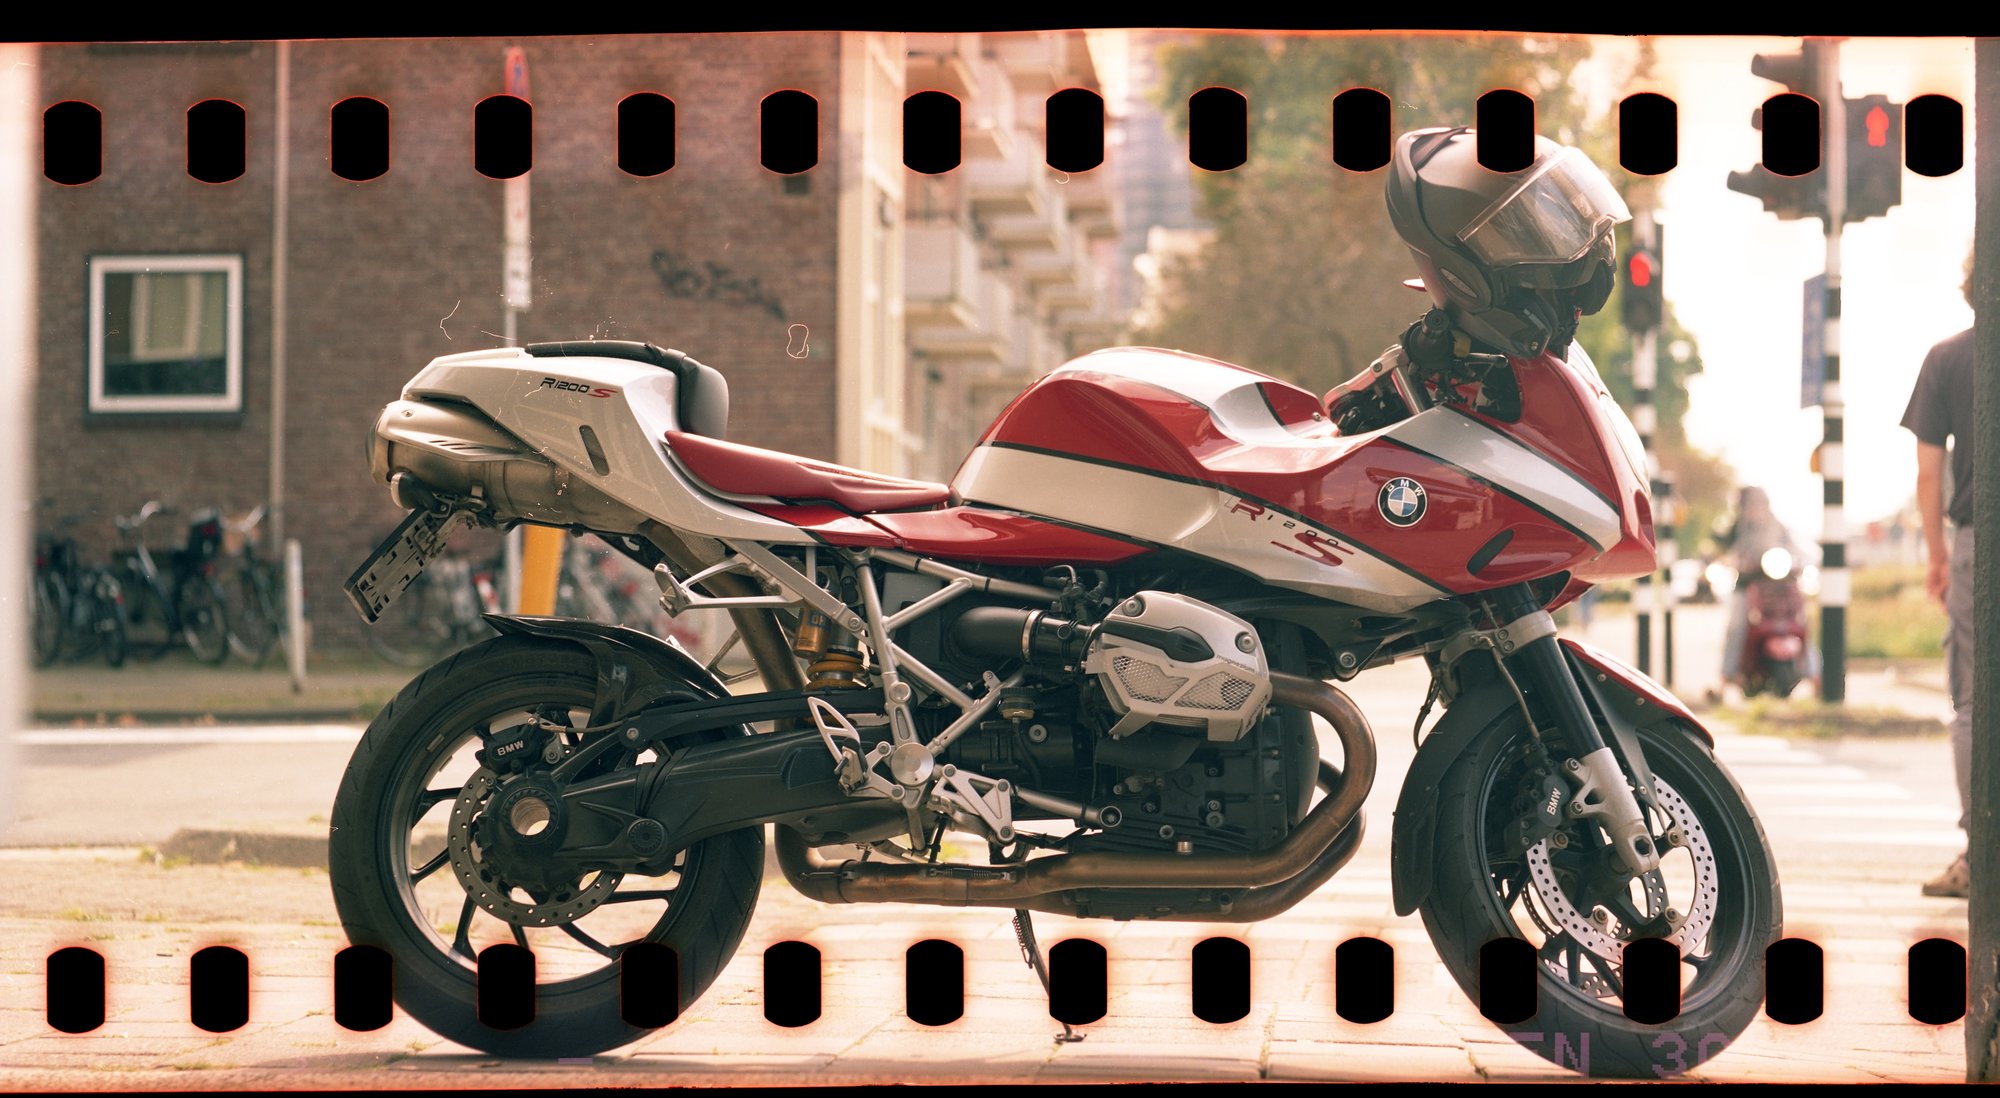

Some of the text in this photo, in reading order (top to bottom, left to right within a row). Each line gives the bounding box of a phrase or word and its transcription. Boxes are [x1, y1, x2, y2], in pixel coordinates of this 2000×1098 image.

[540, 377, 618, 399] R1200 S
[1385, 479, 1424, 497] BMW
[1229, 499, 1339, 547] R1200
[1270, 532, 1355, 567] S
[496, 740, 524, 756] BMW
[1546, 787, 1562, 816] BMW
